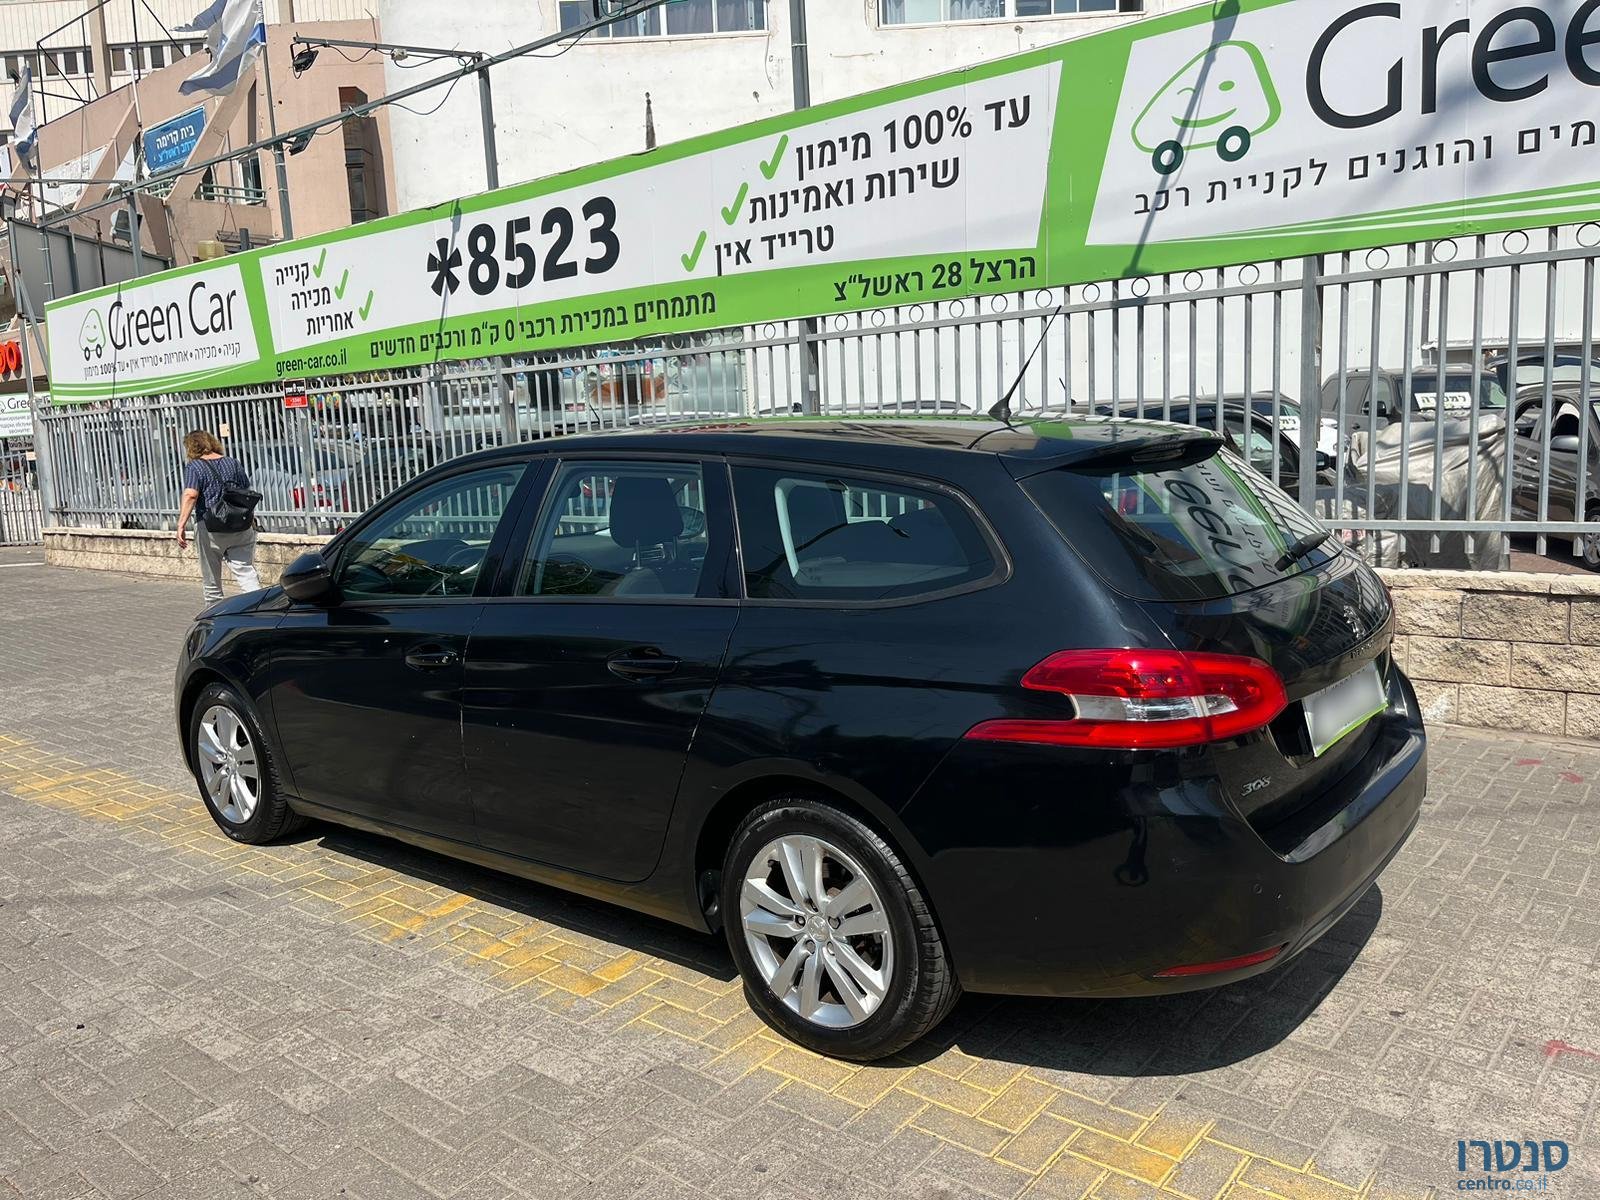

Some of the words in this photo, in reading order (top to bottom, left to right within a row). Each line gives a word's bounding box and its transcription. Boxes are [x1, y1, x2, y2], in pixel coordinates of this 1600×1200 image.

[984, 94, 1030, 131] עד
[180, 125, 195, 140] בית
[883, 105, 972, 153] 100%
[795, 132, 871, 182] מימון
[1348, 135, 1492, 180] והוגנים
[864, 156, 959, 202] שירות
[1206, 158, 1328, 203] לקניית
[749, 178, 854, 224] ואמינות
[1134, 186, 1190, 215] רכב
[760, 224, 834, 260] טרייד
[714, 238, 752, 277] אין
[970, 256, 1036, 284] הרצל
[275, 262, 309, 287] קנייה
[931, 261, 962, 289] 28
[291, 286, 331, 311] מכירה
[634, 291, 716, 323] מתמחים
[108, 300, 183, 351] Green
[188, 281, 237, 336] Car
[306, 310, 354, 336] אחריות
[505, 319, 515, 342] 0
[519, 317, 555, 339] רכבי
[560, 305, 628, 334] במכירת
[195, 345, 217, 361] מכירה
[370, 336, 415, 358] חדשים
[420, 329, 466, 352] ורכבים
[276, 348, 347, 377] green-car.co.il
[1240, 776, 1271, 797] 308
